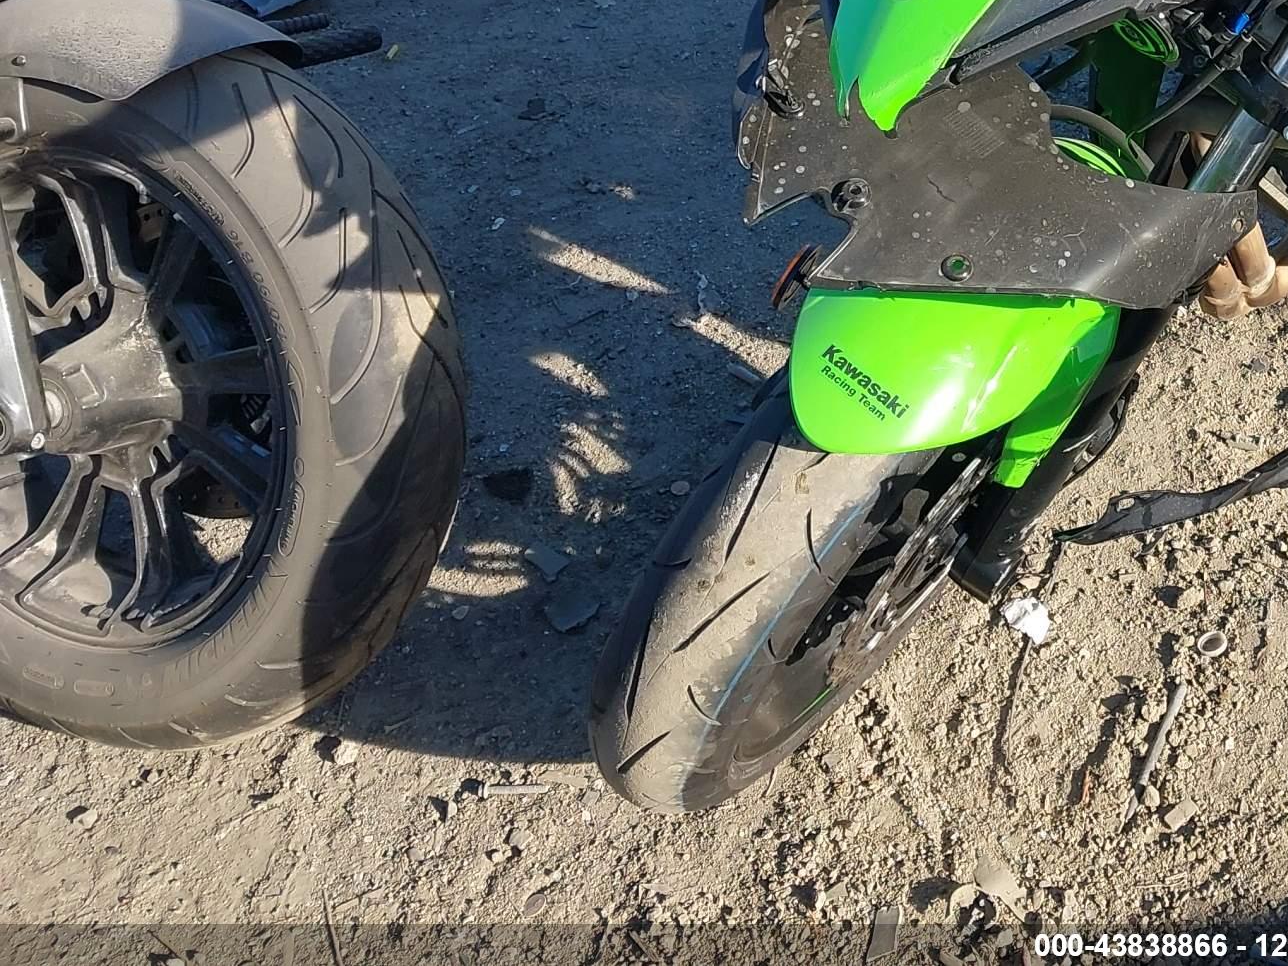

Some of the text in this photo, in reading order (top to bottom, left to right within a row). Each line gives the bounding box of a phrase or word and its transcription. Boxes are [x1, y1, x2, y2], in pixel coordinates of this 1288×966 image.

[820, 365, 886, 422] Racing Team
[821, 344, 910, 419] Kawasaki
